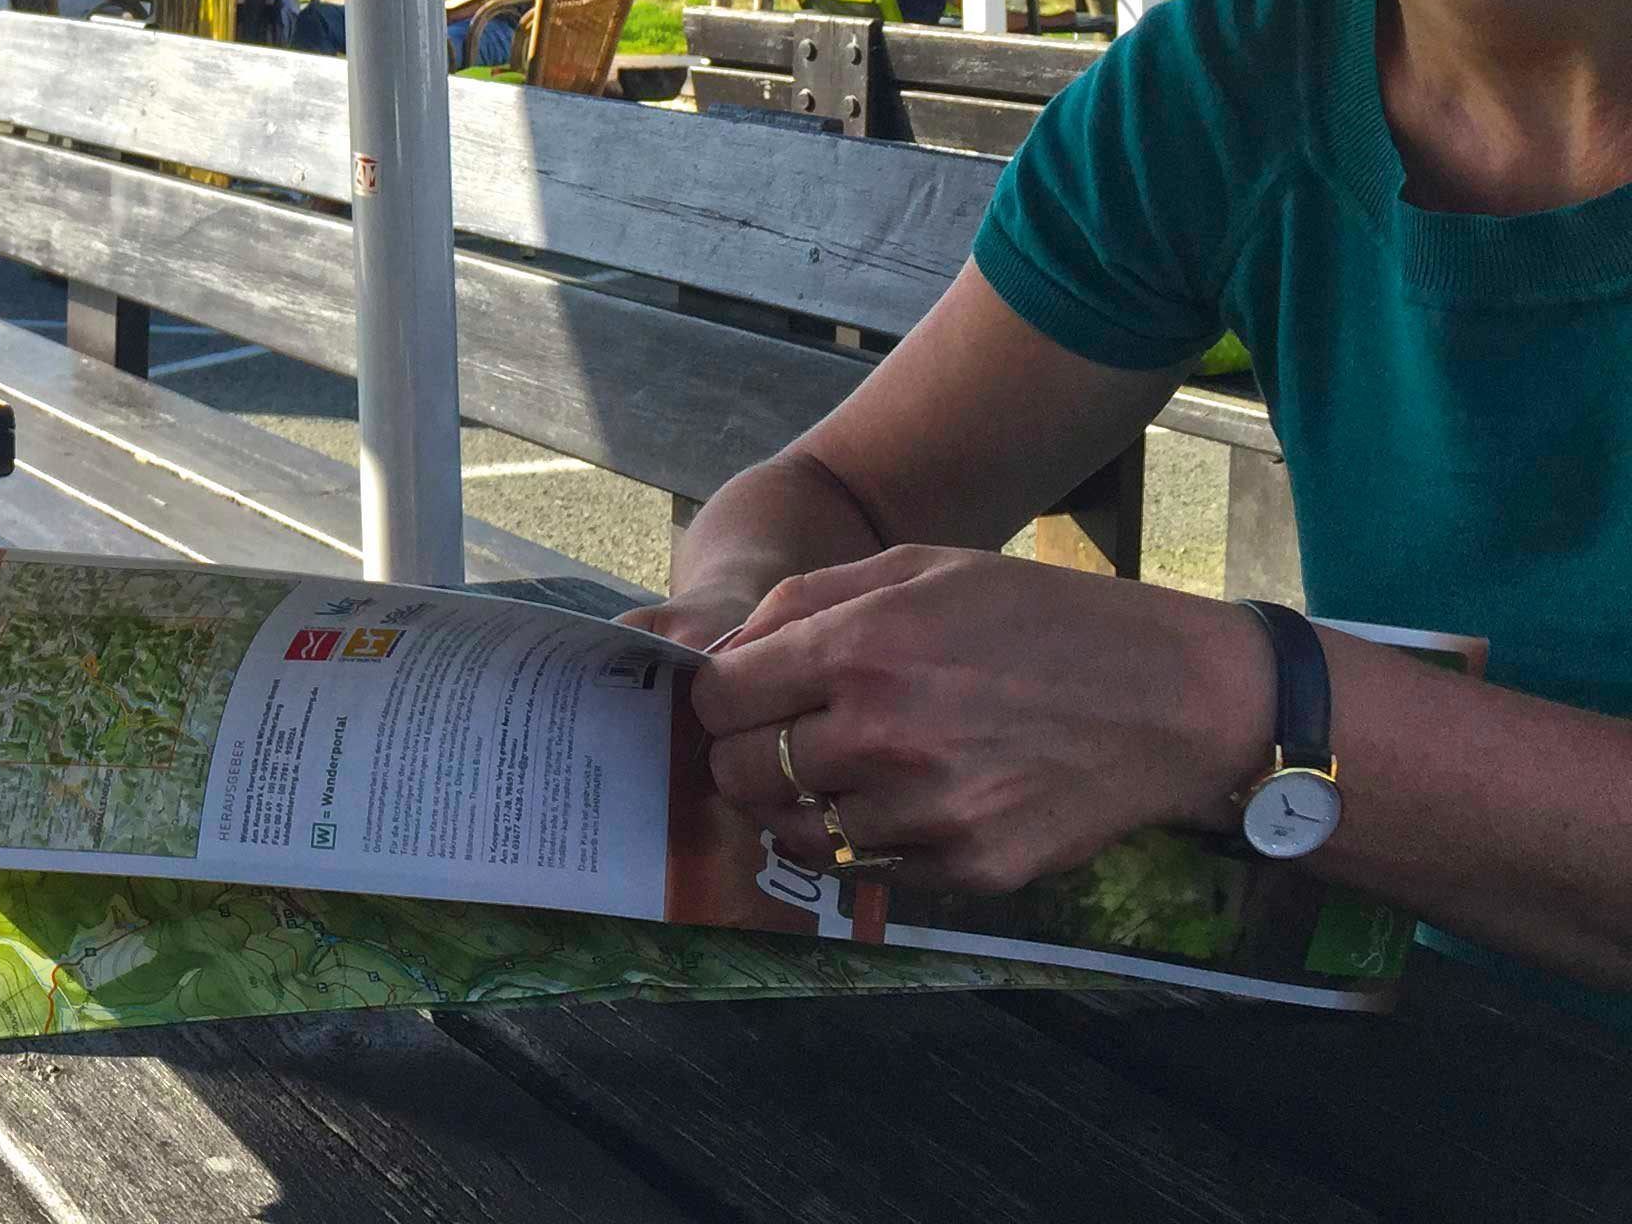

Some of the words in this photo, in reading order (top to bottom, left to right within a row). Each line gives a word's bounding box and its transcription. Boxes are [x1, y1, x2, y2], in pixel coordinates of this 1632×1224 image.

[219, 740, 245, 841] HERAUSGEBER
[321, 716, 348, 806] Wanderportal
[240, 795, 254, 843] Winterberg
